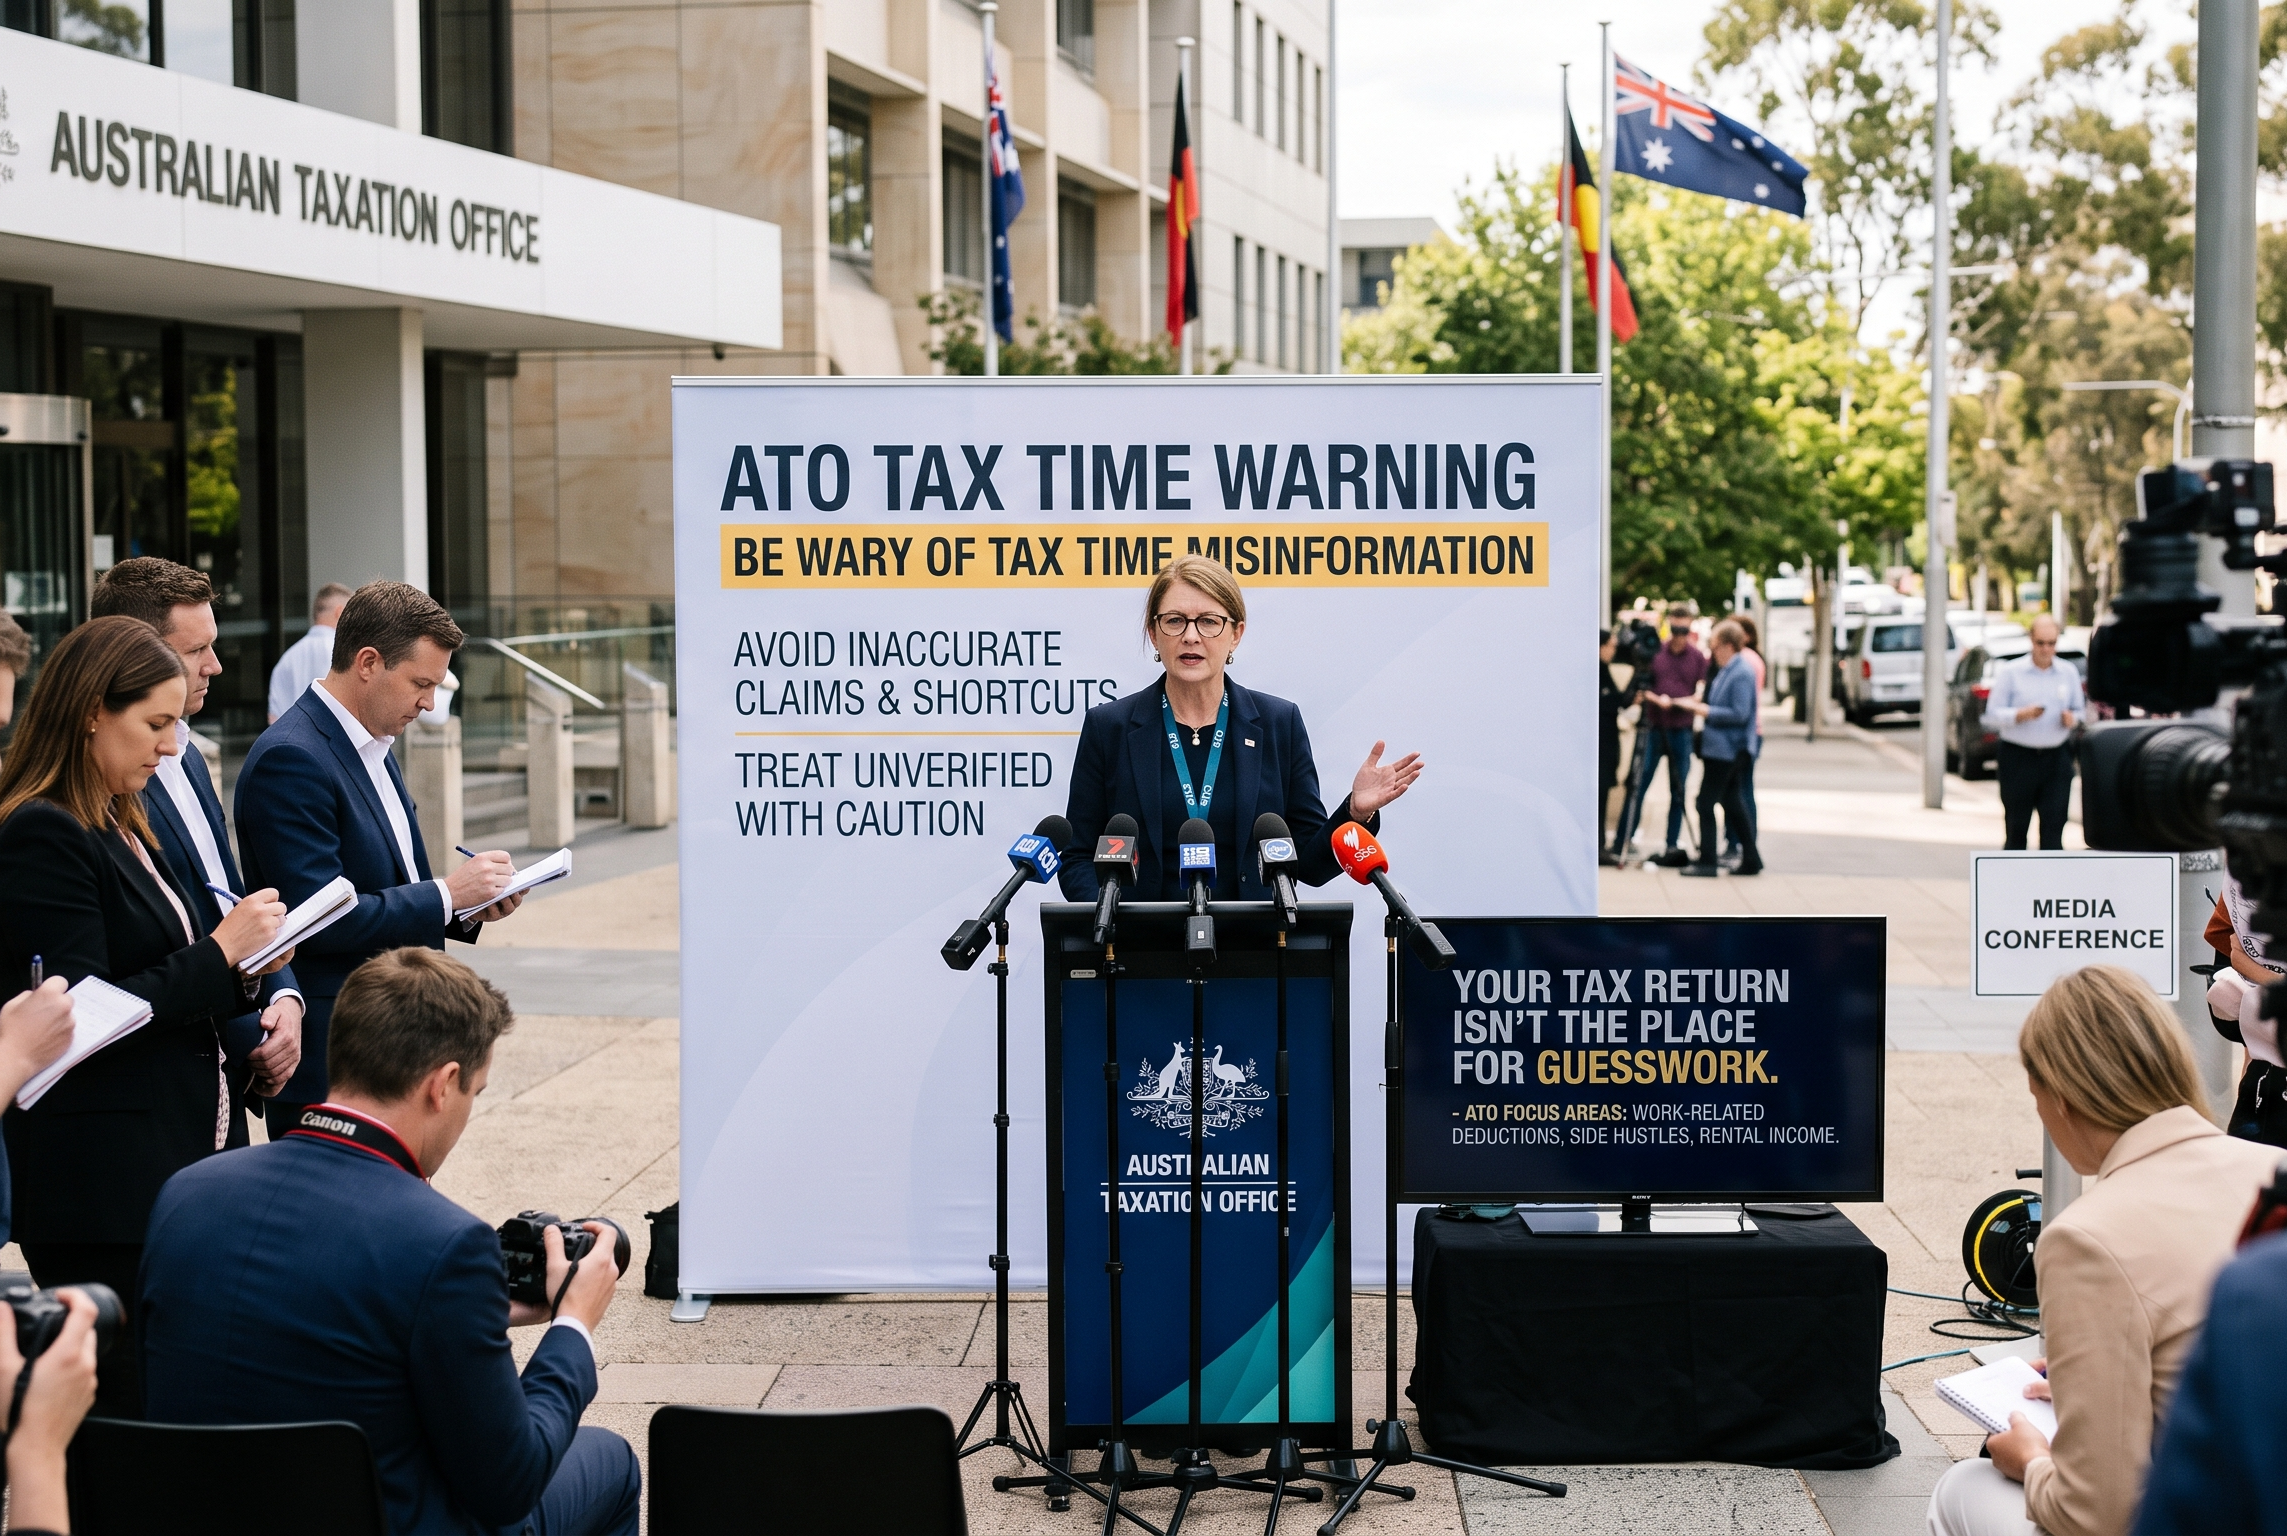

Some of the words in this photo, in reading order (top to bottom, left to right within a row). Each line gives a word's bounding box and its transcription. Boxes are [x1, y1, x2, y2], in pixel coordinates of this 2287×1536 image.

[51, 111, 281, 216] AUSTRALIAN
[294, 164, 439, 245] TAXATION
[450, 199, 540, 264] OFFICE
[720, 444, 850, 512] ATO
[873, 444, 1005, 511] TAX
[1026, 444, 1192, 511] TIME
[1213, 442, 1536, 511] WARNING
[734, 537, 784, 577] BE
[796, 537, 913, 577] WARY
[926, 537, 976, 577] OF
[988, 537, 1065, 576] TAX
[1076, 536, 1172, 576] TIME
[733, 630, 835, 668] AVOID
[849, 630, 1062, 667] INACCURATE
[735, 679, 865, 716] CLAIMS
[877, 679, 902, 716] &
[913, 678, 1118, 716] SHORTCUTS
[734, 752, 843, 788] TREAT
[854, 752, 1053, 789] UNVERIFIED
[735, 800, 823, 837] WITH
[836, 799, 984, 837] CAUTION
[2033, 899, 2116, 919] MEDIA
[1984, 929, 2164, 950] CONFERENCE
[1452, 969, 1552, 1004] YOUR
[1562, 969, 1633, 1003] TAX
[1644, 968, 1790, 1004] RETURN
[1453, 1009, 1548, 1044] ISN'T
[1557, 1009, 1628, 1044] THE
[1640, 1008, 1756, 1044] PLACE
[1453, 1049, 1525, 1085] FOR
[1537, 1049, 1779, 1085] GUESSWORK.
[301, 1111, 357, 1136] Canon
[1464, 1104, 1498, 1122] ATO
[1503, 1103, 1560, 1122] FOCUS
[1563, 1103, 1627, 1121] AREAS:
[1632, 1103, 1765, 1121] WORK-RELATED
[1452, 1127, 1565, 1147] DEDUCTIONS,
[1569, 1127, 1608, 1145] SIDE
[1613, 1126, 1694, 1147] HUSTLES,
[1699, 1126, 1764, 1144] RENTAL
[1769, 1126, 1840, 1144] INCOME.
[1126, 1153, 1269, 1176] AUSTALIAN
